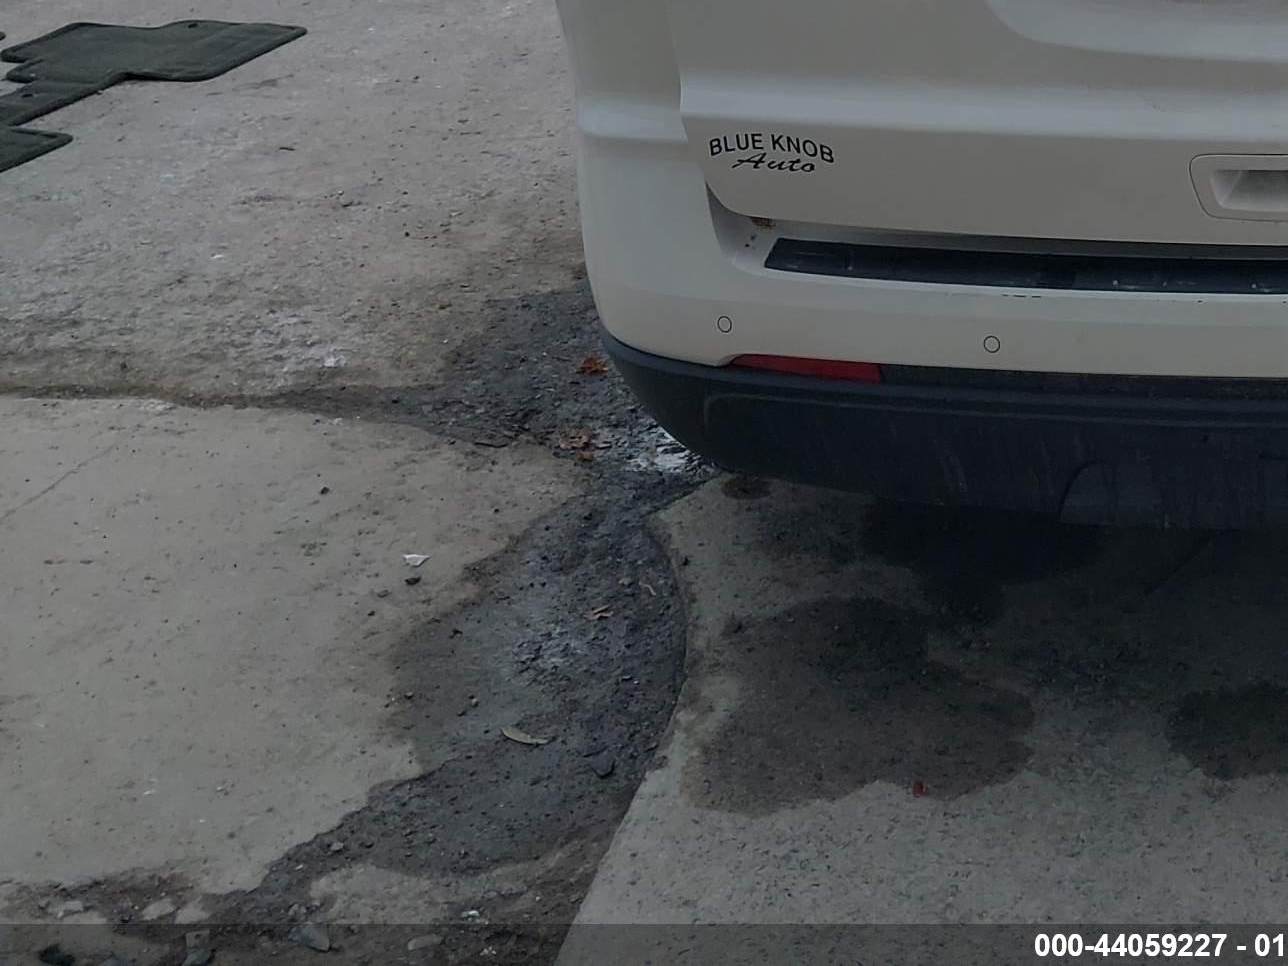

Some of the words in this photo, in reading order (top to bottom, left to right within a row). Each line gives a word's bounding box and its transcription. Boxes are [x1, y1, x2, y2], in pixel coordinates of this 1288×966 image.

[708, 132, 765, 157] BLUE
[770, 132, 836, 164] KNOB
[731, 151, 815, 173] Auto
